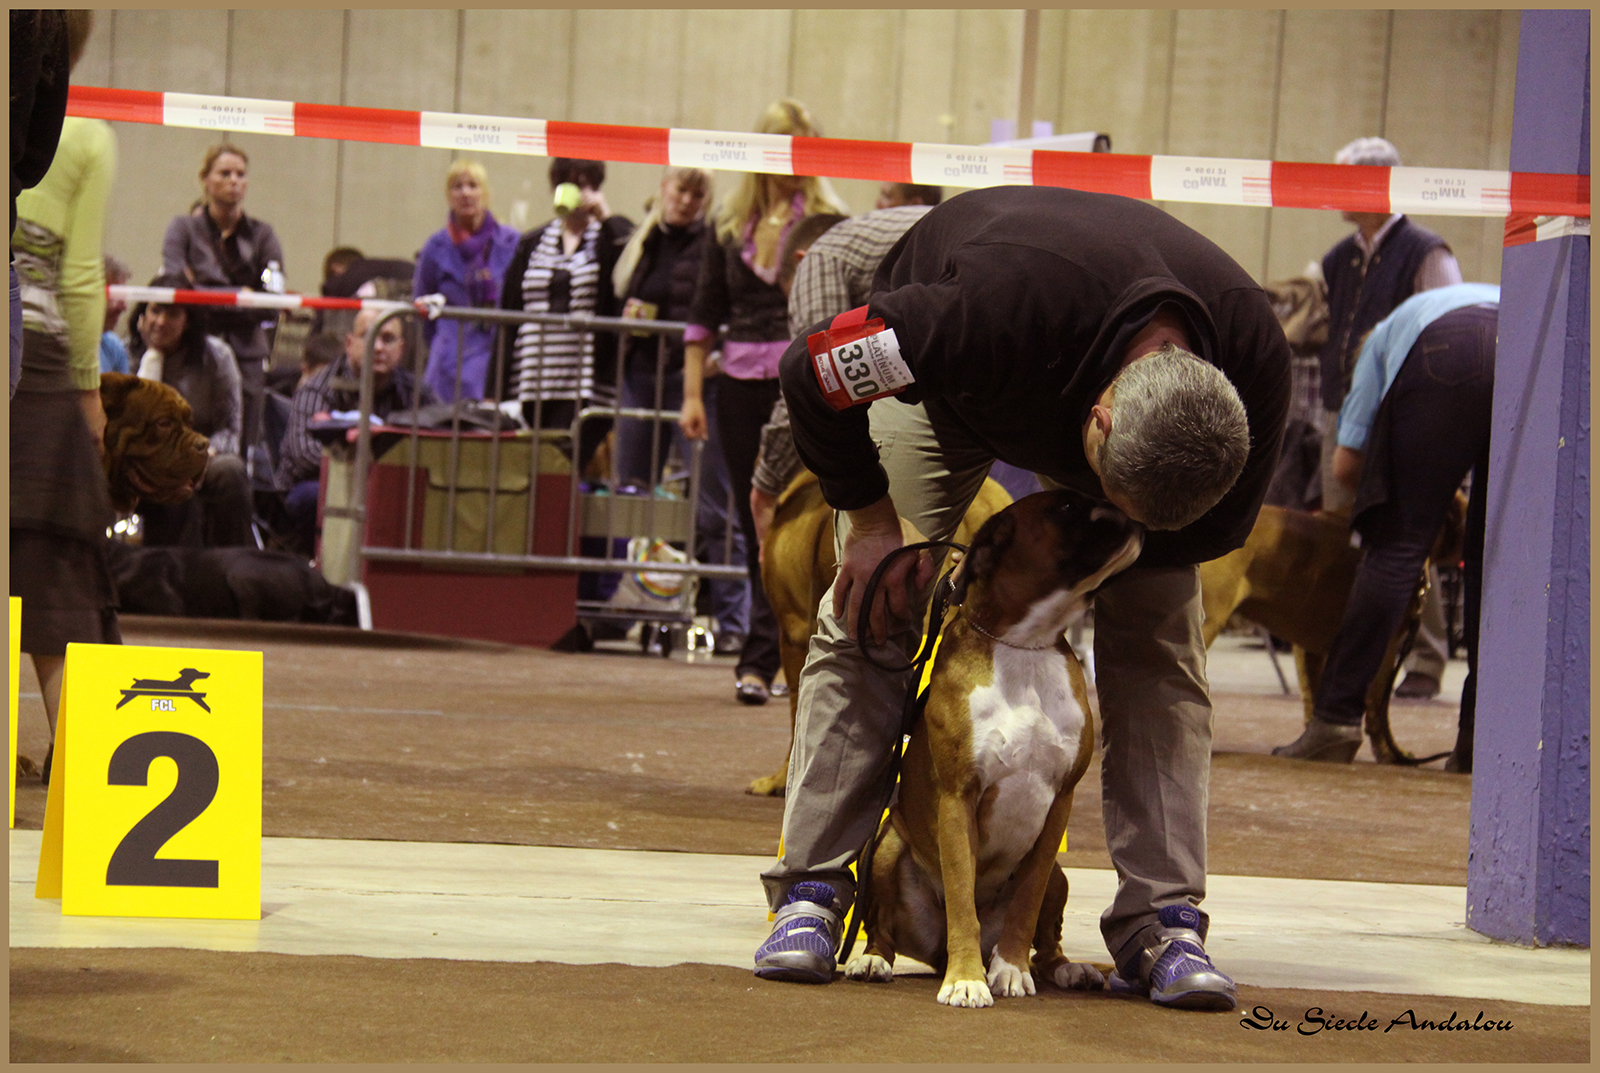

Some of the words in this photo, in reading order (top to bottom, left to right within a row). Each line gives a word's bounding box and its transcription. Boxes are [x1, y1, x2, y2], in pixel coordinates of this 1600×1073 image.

[838, 344, 880, 398] 330
[870, 334, 896, 384] PLATINUM
[151, 699, 176, 712] FCL
[106, 731, 220, 888] 2
